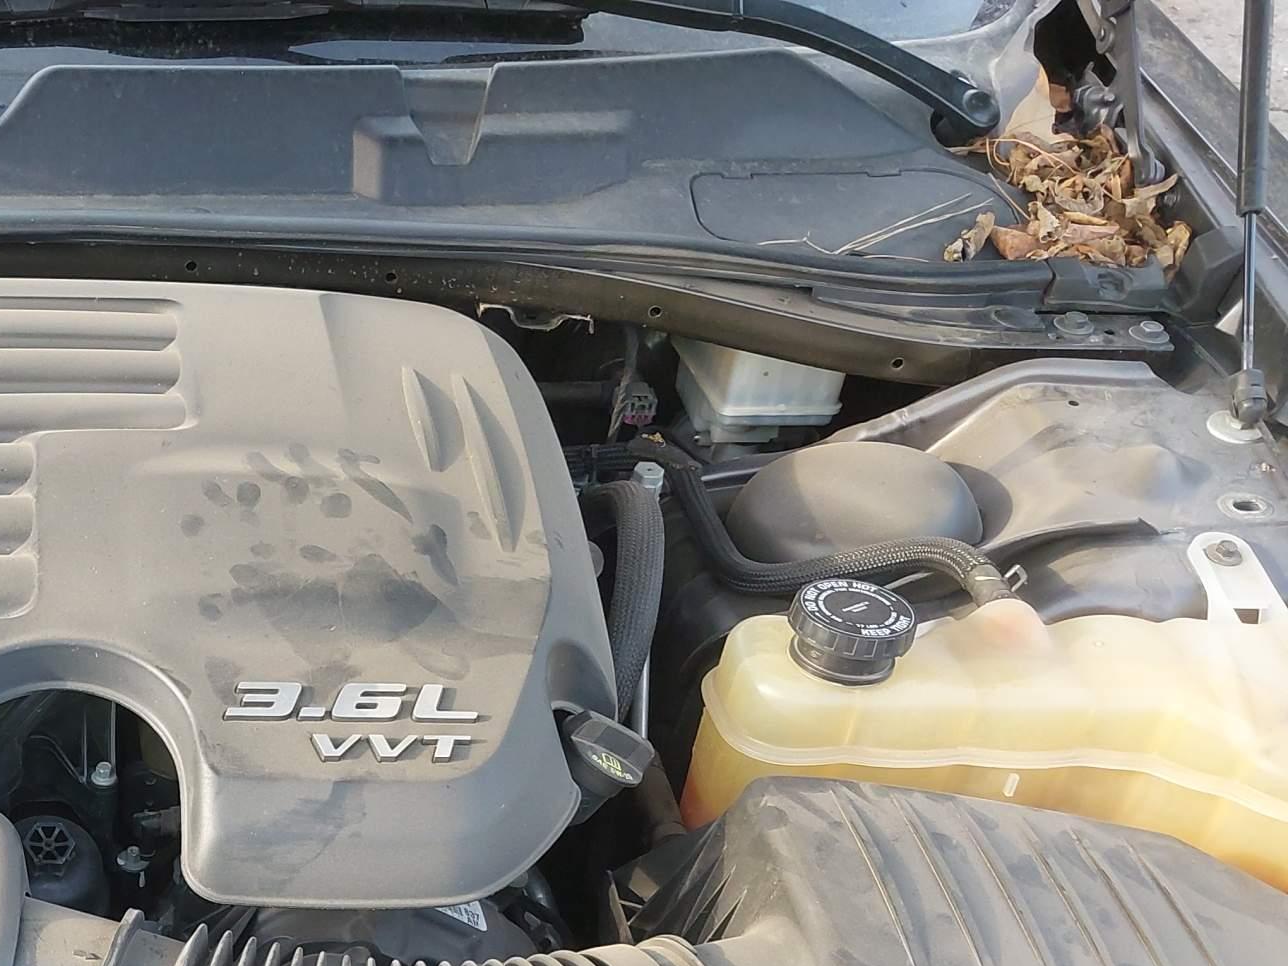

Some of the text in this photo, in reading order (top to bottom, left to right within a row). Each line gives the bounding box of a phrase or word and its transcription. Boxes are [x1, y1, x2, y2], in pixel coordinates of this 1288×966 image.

[804, 581, 878, 612] DO NOT OPEN HOT
[860, 615, 912, 637] KEEP TIGHT
[223, 682, 480, 723] 3.6L
[311, 733, 472, 763] VVT
